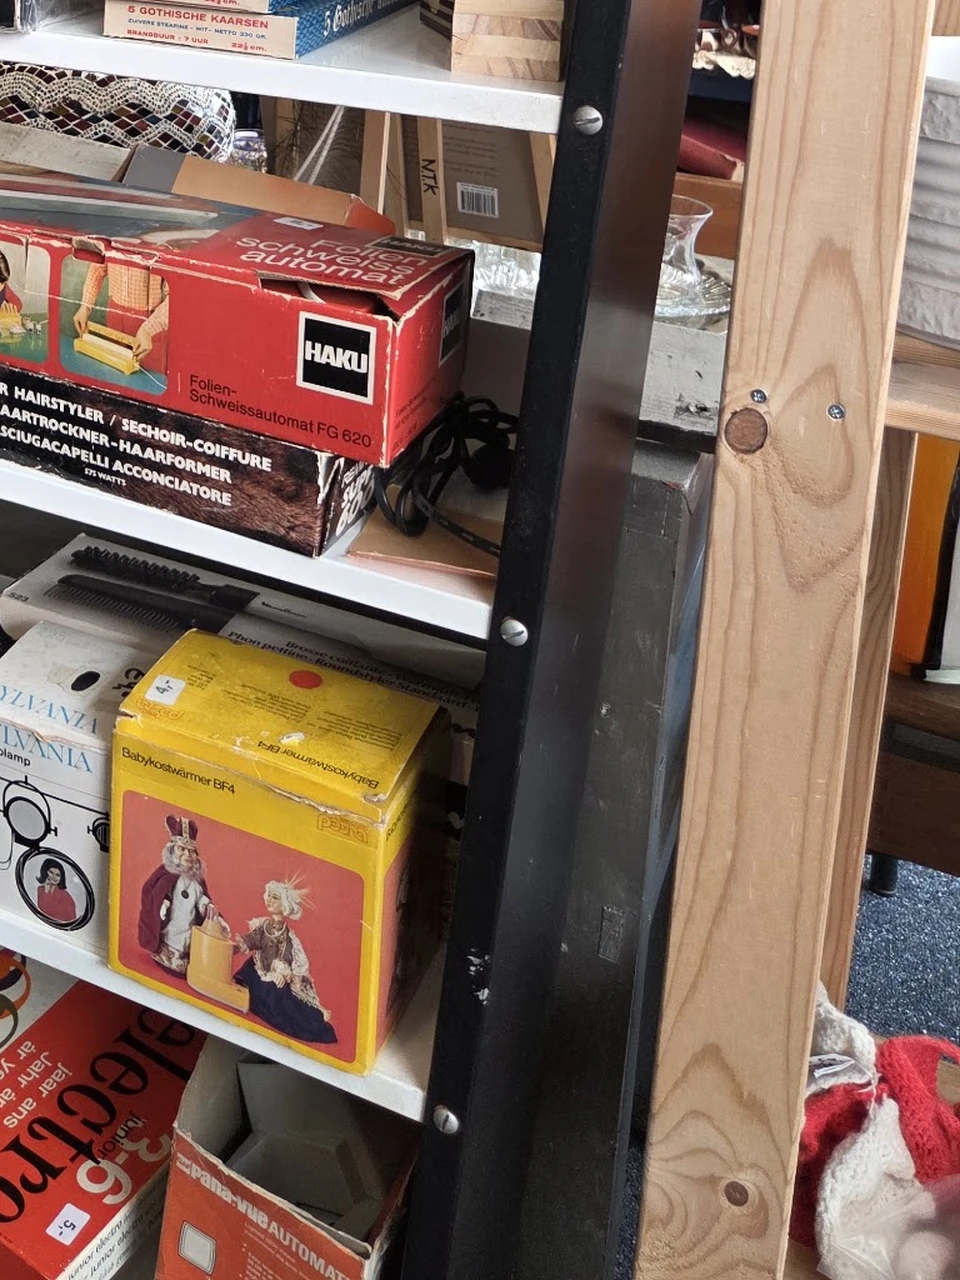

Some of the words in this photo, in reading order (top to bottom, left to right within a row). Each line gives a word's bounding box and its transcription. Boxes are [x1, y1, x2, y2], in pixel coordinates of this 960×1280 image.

[127, 5, 136, 14] 5
[139, 6, 207, 22] GOTHISCHE
[210, 14, 269, 29] KAARSEN
[127, 18, 155, 27] ZUIVERE
[214, 28, 237, 36] NETTO
[323, 10, 331, 37] 5
[126, 29, 176, 41] BRANDDUUR
[191, 37, 209, 45] UUR
[236, 235, 416, 277] schweiss
[239, 249, 407, 286] automat
[304, 340, 368, 374] HAKU
[189, 374, 237, 397] Folien-
[14, 385, 105, 425] HAIRSTYLER
[121, 417, 273, 473] SECHOIR-COIFFURE
[189, 389, 315, 434] Schweissautomat
[316, 421, 339, 440] FG
[341, 427, 372, 449] 620
[97, 470, 127, 487] WATTS
[111, 459, 233, 508] ACCONCIATORE
[228, 630, 261, 647] Phon
[261, 640, 308, 661] pettine
[314, 656, 397, 689] Roundstyler
[285, 640, 329, 658] Brosse
[155, 679, 174, 696] 4,-
[256, 739, 280, 755] BF4
[121, 746, 213, 787] Babykostwärmer
[213, 778, 236, 796] BF4
[281, 746, 380, 789] Babykostwärmer
[17, 1050, 53, 1088] Jahr
[38, 1061, 73, 1099] jaar
[2, 1096, 37, 1129] ans
[100, 1109, 148, 1161] junior
[75, 1123, 172, 1206] 3-6
[58, 1218, 77, 1237] 5,-
